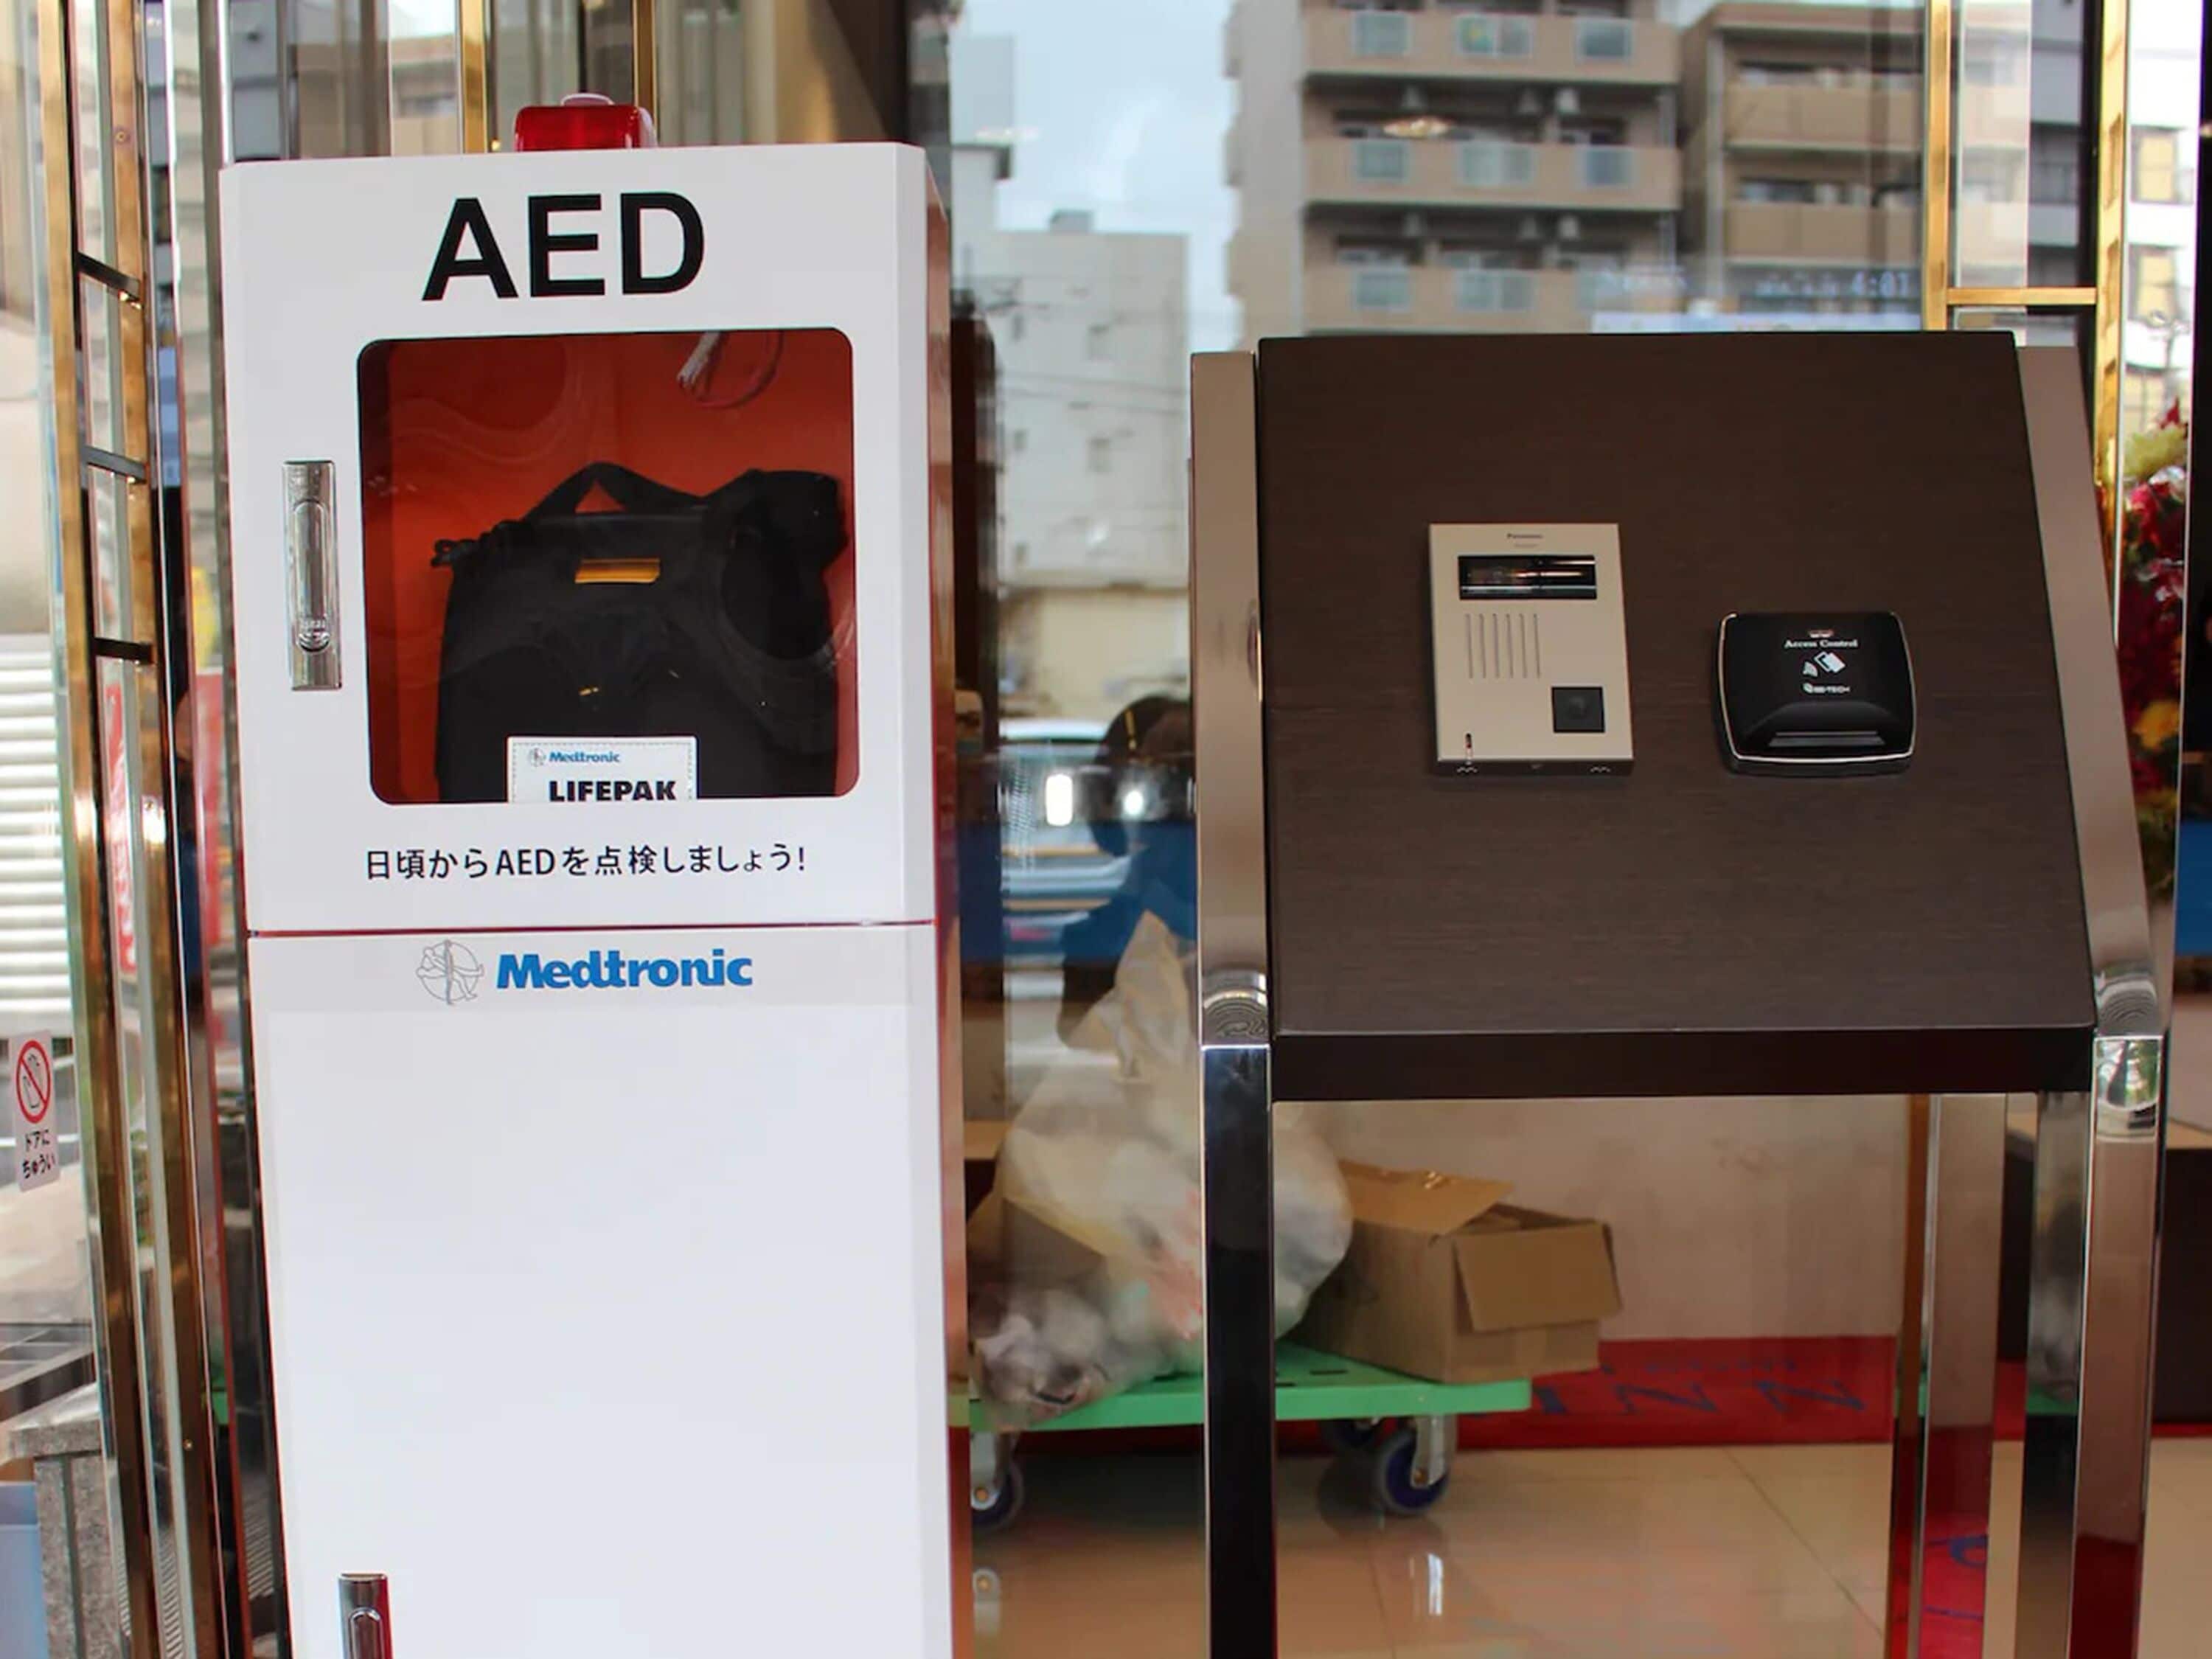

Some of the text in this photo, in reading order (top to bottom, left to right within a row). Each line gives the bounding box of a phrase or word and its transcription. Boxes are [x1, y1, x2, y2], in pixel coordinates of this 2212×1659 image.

[422, 192, 705, 301] AED
[1784, 639, 1858, 648] Access Control
[549, 751, 620, 763] Medtronic
[549, 780, 677, 802] LIFEPAK
[366, 842, 806, 880] 日頃からAEDを点検しましょう!
[496, 948, 754, 989] Medtronic
